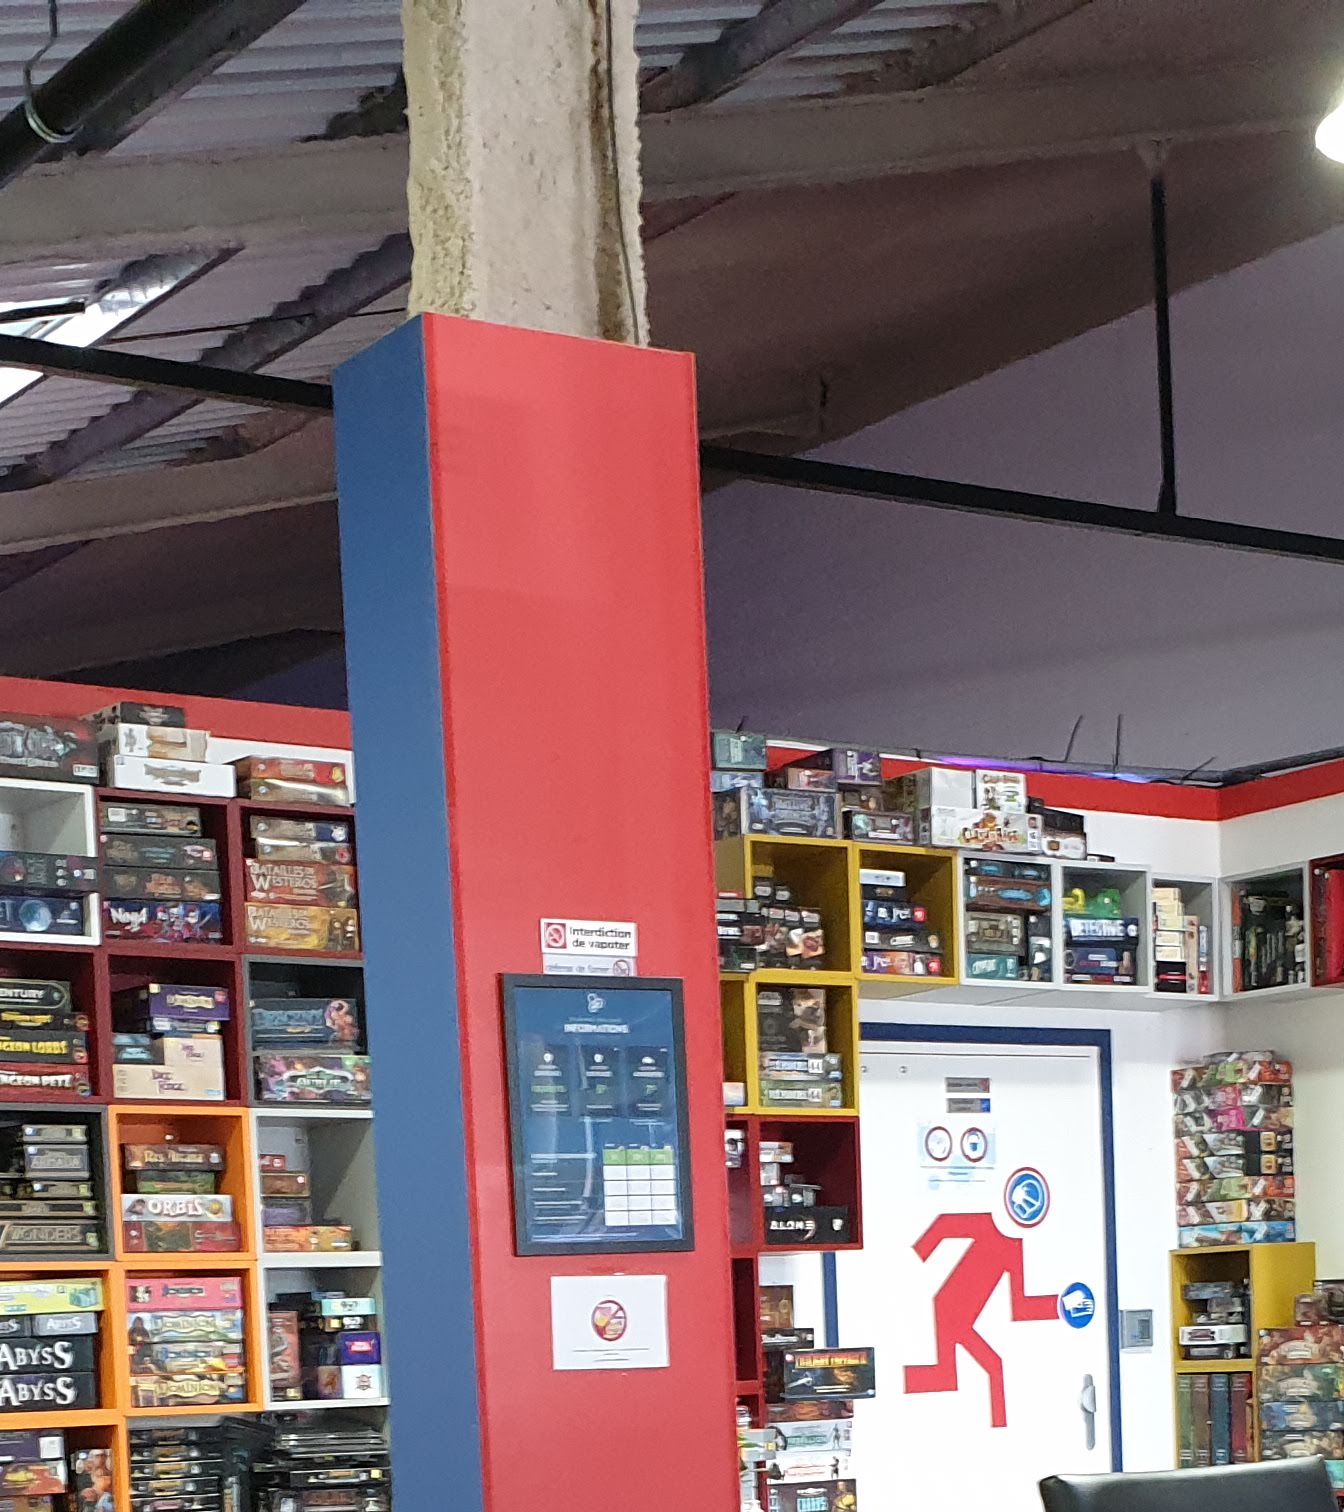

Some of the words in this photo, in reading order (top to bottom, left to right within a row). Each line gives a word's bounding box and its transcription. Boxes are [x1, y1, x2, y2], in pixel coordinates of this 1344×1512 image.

[569, 926, 632, 939] Interdiction
[572, 938, 586, 949] de
[588, 939, 631, 951] vapoter
